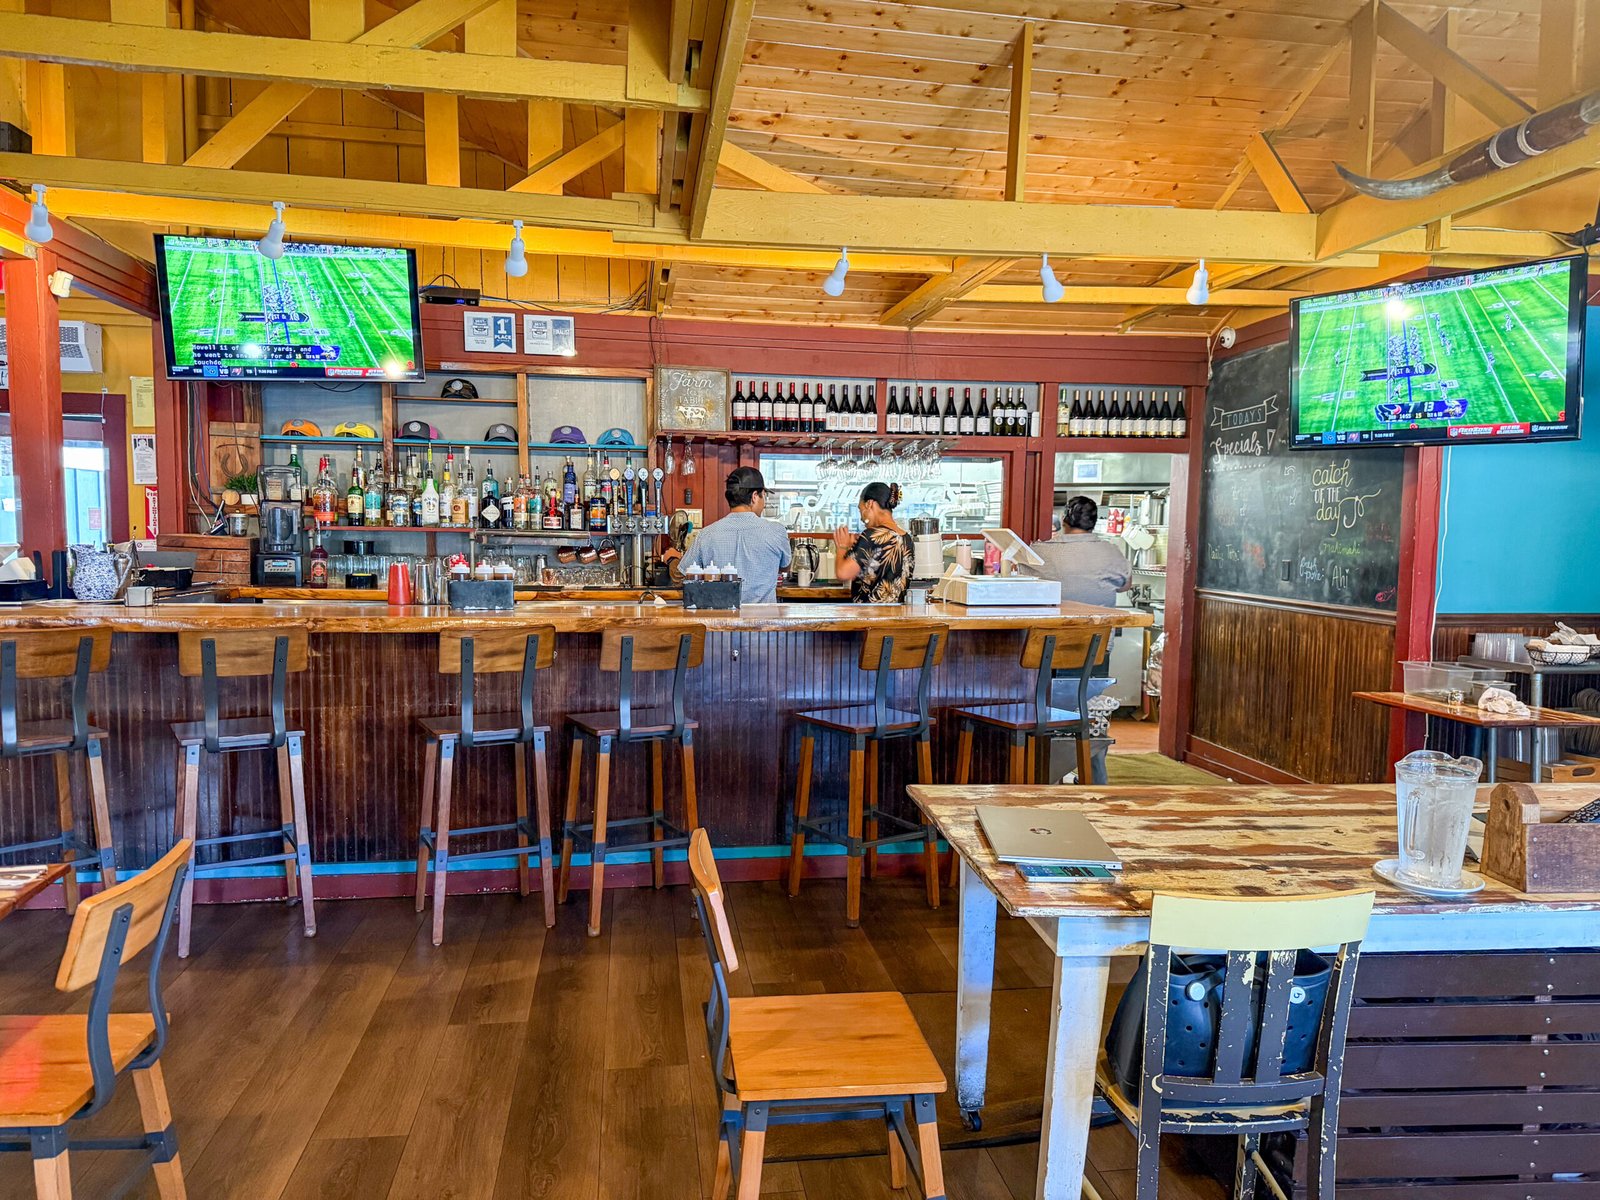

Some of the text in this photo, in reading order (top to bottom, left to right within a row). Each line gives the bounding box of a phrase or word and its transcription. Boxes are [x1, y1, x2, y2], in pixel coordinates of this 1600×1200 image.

[669, 372, 715, 391] Farm
[1408, 401, 1435, 413] 7 13
[1226, 408, 1262, 427] TODAYS
[1336, 434, 1346, 442] VS
[1312, 459, 1354, 488] catch
[1314, 487, 1342, 504] OF THE
[1316, 498, 1341, 537] day
[1331, 565, 1350, 591] Ahi
